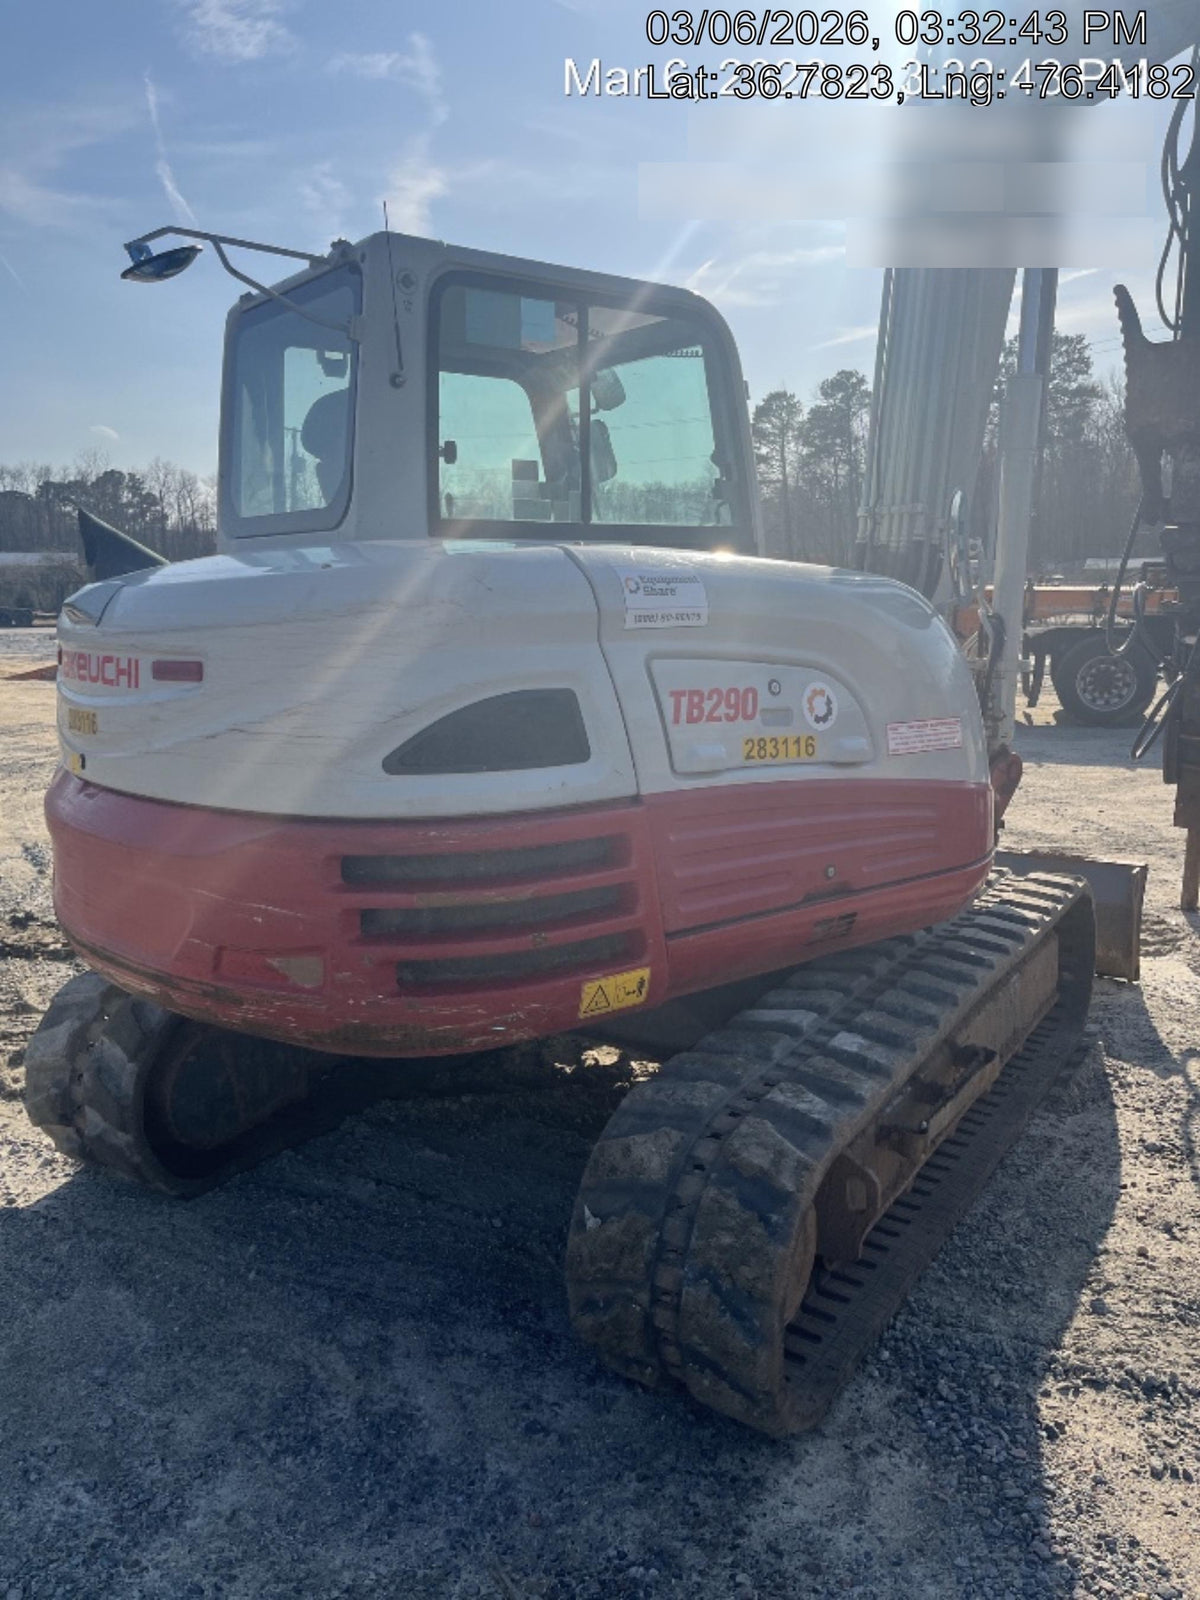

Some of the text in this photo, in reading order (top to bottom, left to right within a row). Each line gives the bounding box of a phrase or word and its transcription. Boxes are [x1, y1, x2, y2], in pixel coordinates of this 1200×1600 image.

[643, 586, 677, 596] Share
[668, 686, 759, 725] TB290
[744, 735, 816, 760] 283116
